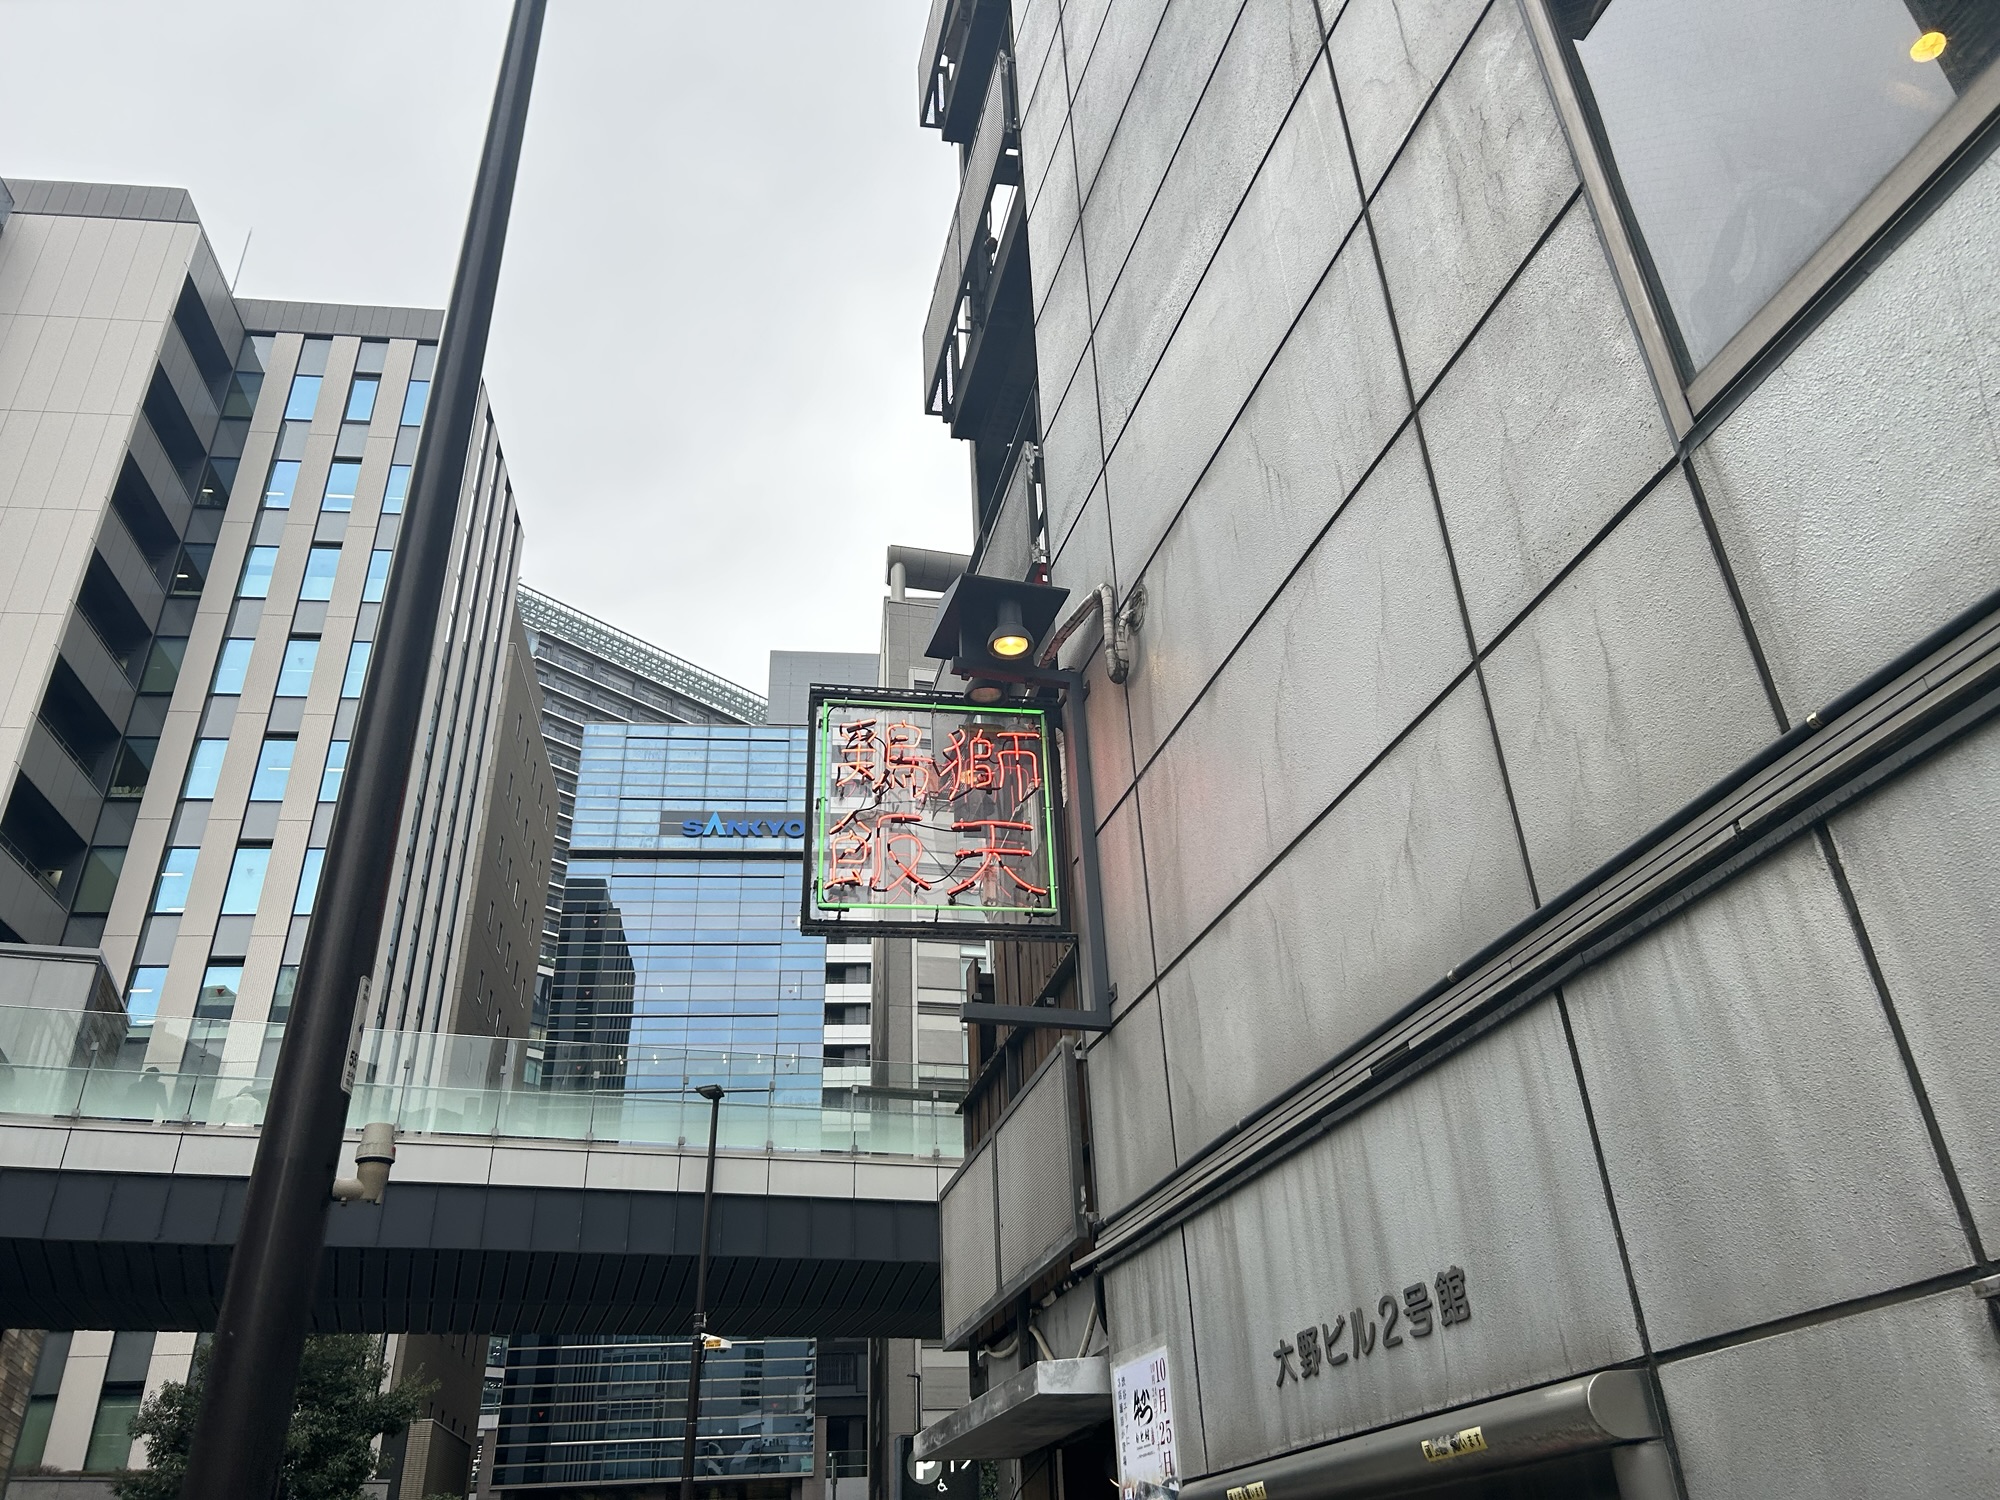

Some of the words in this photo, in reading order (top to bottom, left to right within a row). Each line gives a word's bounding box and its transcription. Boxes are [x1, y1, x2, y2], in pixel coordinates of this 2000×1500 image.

[682, 811, 804, 838] SANKYO
[1273, 1265, 1471, 1387] 大野ビル2号館
[1155, 1357, 1172, 1477] 10月25日
